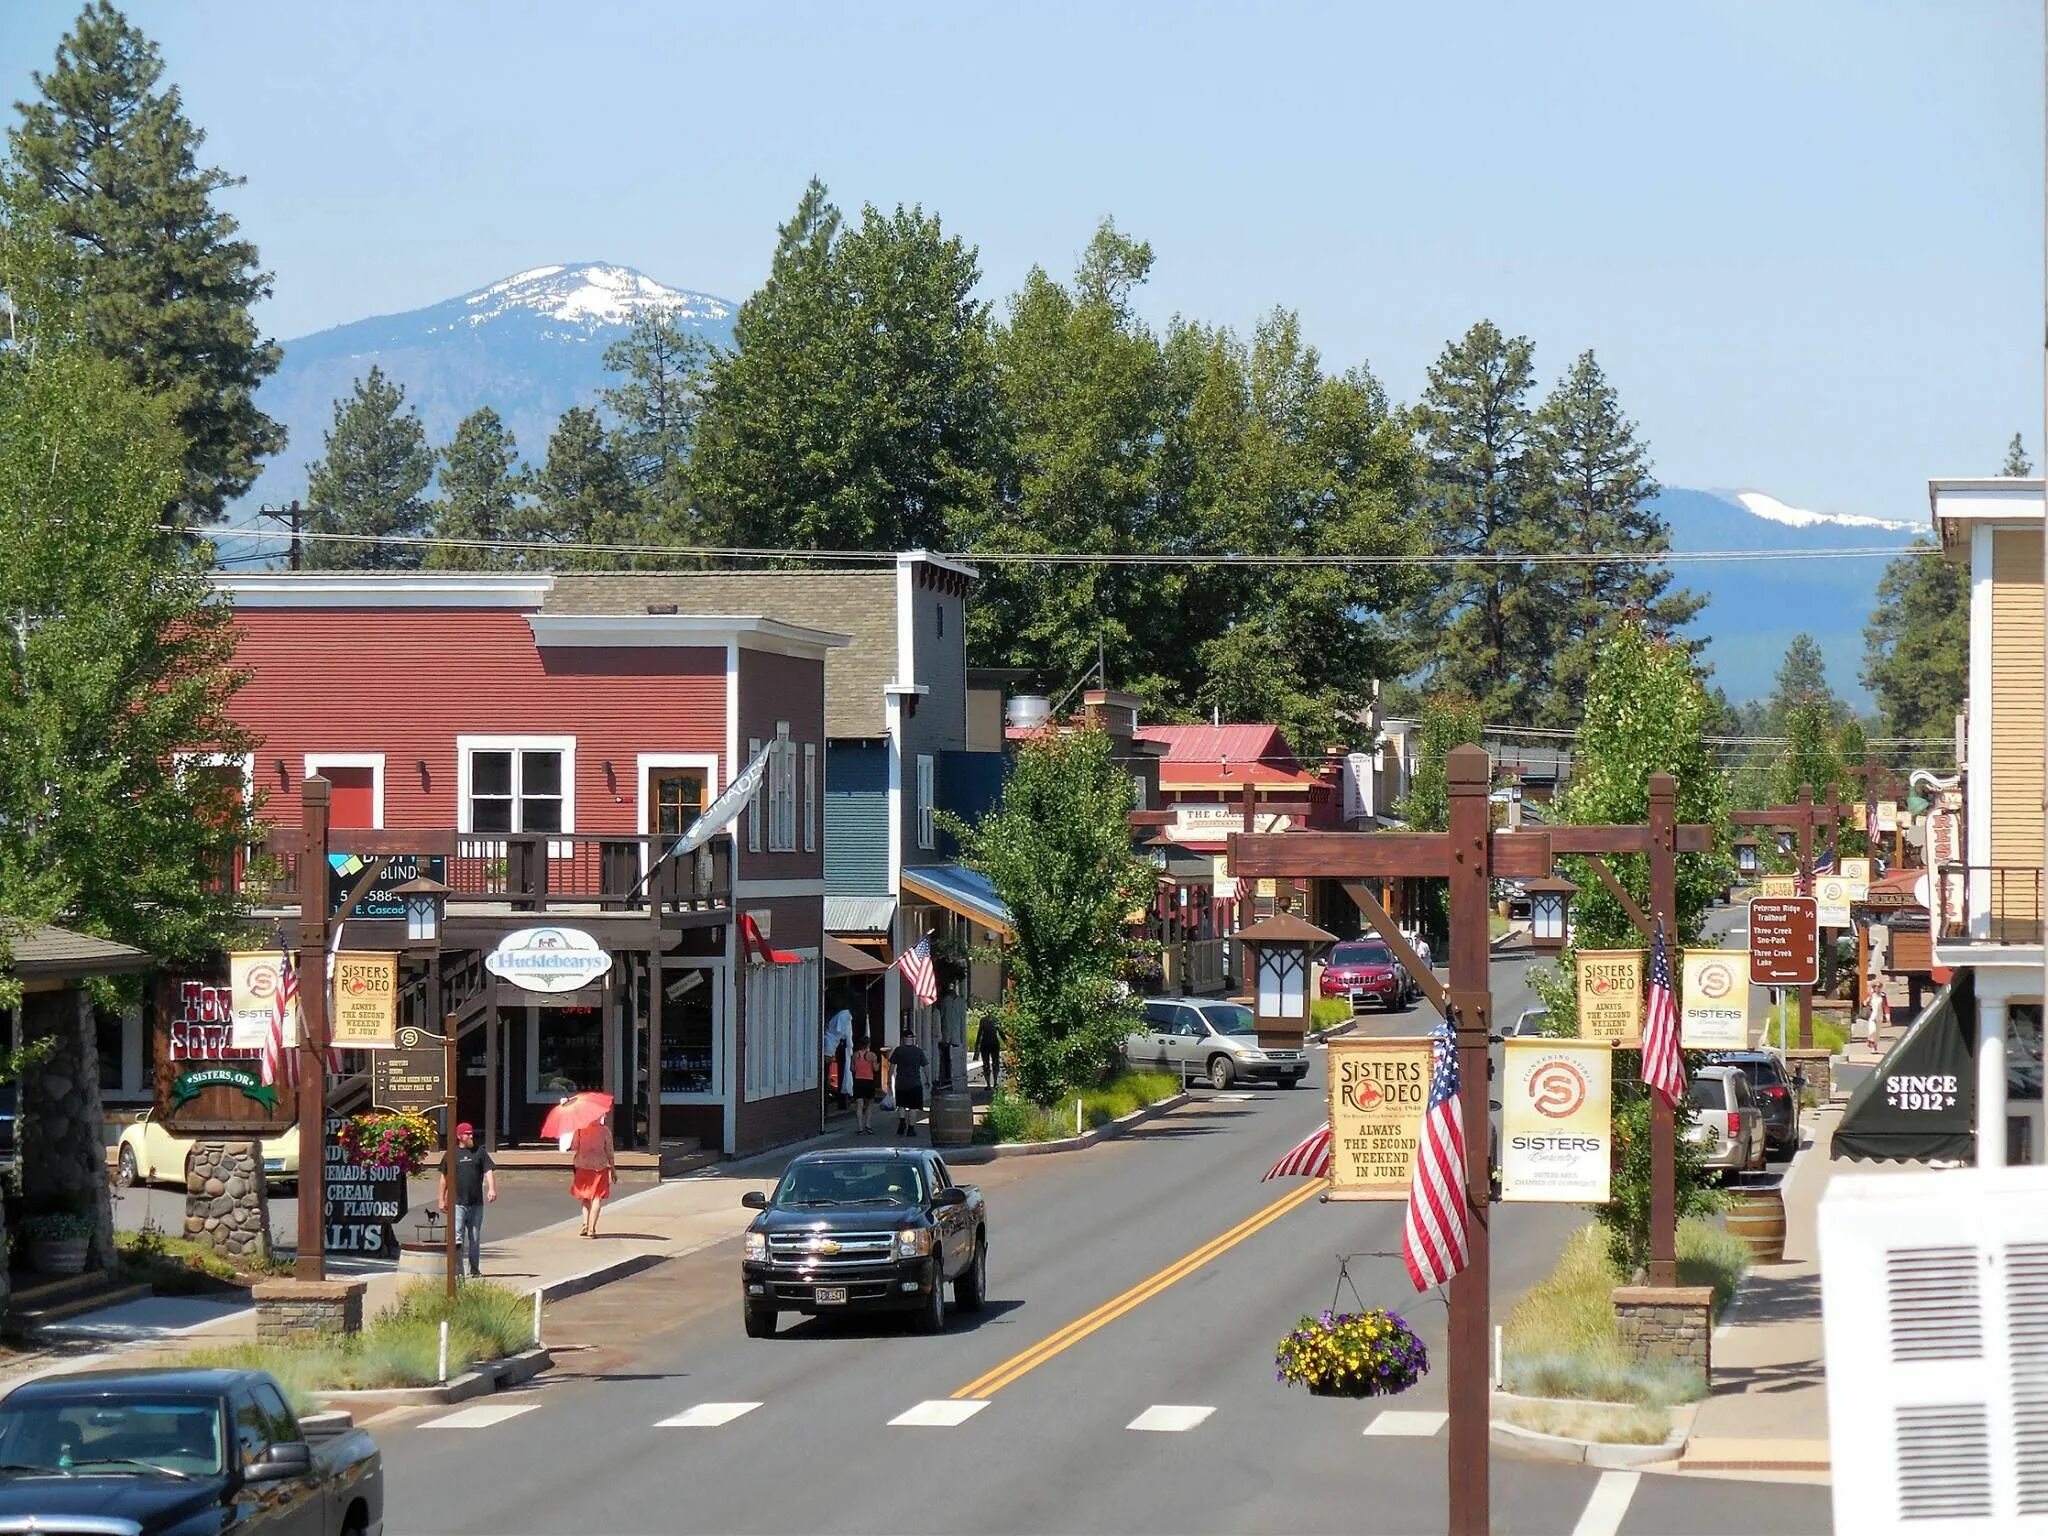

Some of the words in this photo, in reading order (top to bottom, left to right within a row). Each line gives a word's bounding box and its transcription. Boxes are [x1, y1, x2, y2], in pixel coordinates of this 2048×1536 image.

[1187, 810, 1211, 819] THE
[381, 866, 421, 880] BLIND
[355, 905, 365, 914] E.
[367, 905, 406, 914] Cascad
[1753, 904, 1781, 912] Peterson
[1783, 904, 1801, 914] Ridge
[1757, 914, 1787, 922] Trailhead
[1753, 927, 1772, 935] Three
[1773, 927, 1792, 935] Creek
[1757, 936, 1786, 944] Sno-Park
[498, 952, 601, 973] Hucklebearys
[342, 965, 389, 978] SiSTERS
[1585, 965, 1633, 978] SiSTERS
[342, 976, 390, 996] RODEO
[1585, 975, 1634, 996] RODEO
[181, 981, 232, 1022] TOW
[351, 1003, 376, 1011] ALWAYS
[238, 1009, 289, 1019] SISTES
[342, 1011, 356, 1019] THE
[359, 1011, 385, 1019] SECOND
[561, 1005, 592, 1014] OPEN
[1603, 1011, 1631, 1019] SECOND
[1687, 1009, 1742, 1019] SISTERS
[346, 1020, 380, 1028] WEEKEND
[348, 1028, 357, 1036] IN
[359, 1028, 378, 1036] JUNE
[1594, 1028, 1603, 1036] IN
[1605, 1028, 1624, 1036] JUNE
[1341, 1061, 1421, 1082] SiSTERS
[192, 1070, 235, 1084] SISTERS,
[235, 1072, 250, 1086] OR
[1886, 1075, 1958, 1094] SINCE
[1341, 1079, 1421, 1113] RODEO
[1900, 1093, 1944, 1111] 1912
[1359, 1124, 1402, 1136] ALWAYS
[1344, 1138, 1368, 1150] THE
[1372, 1138, 1417, 1150] SECOND
[1511, 1136, 1600, 1152] SISTERS
[1352, 1152, 1409, 1163] WEEKEND
[325, 1165, 367, 1181] EMADE
[369, 1165, 400, 1182] SOUP
[1356, 1166, 1368, 1177] IN
[1374, 1166, 1405, 1177] JUNE
[327, 1184, 374, 1200] CREAM
[343, 1201, 399, 1217] FLAVORS
[325, 1223, 382, 1251] LI'S
